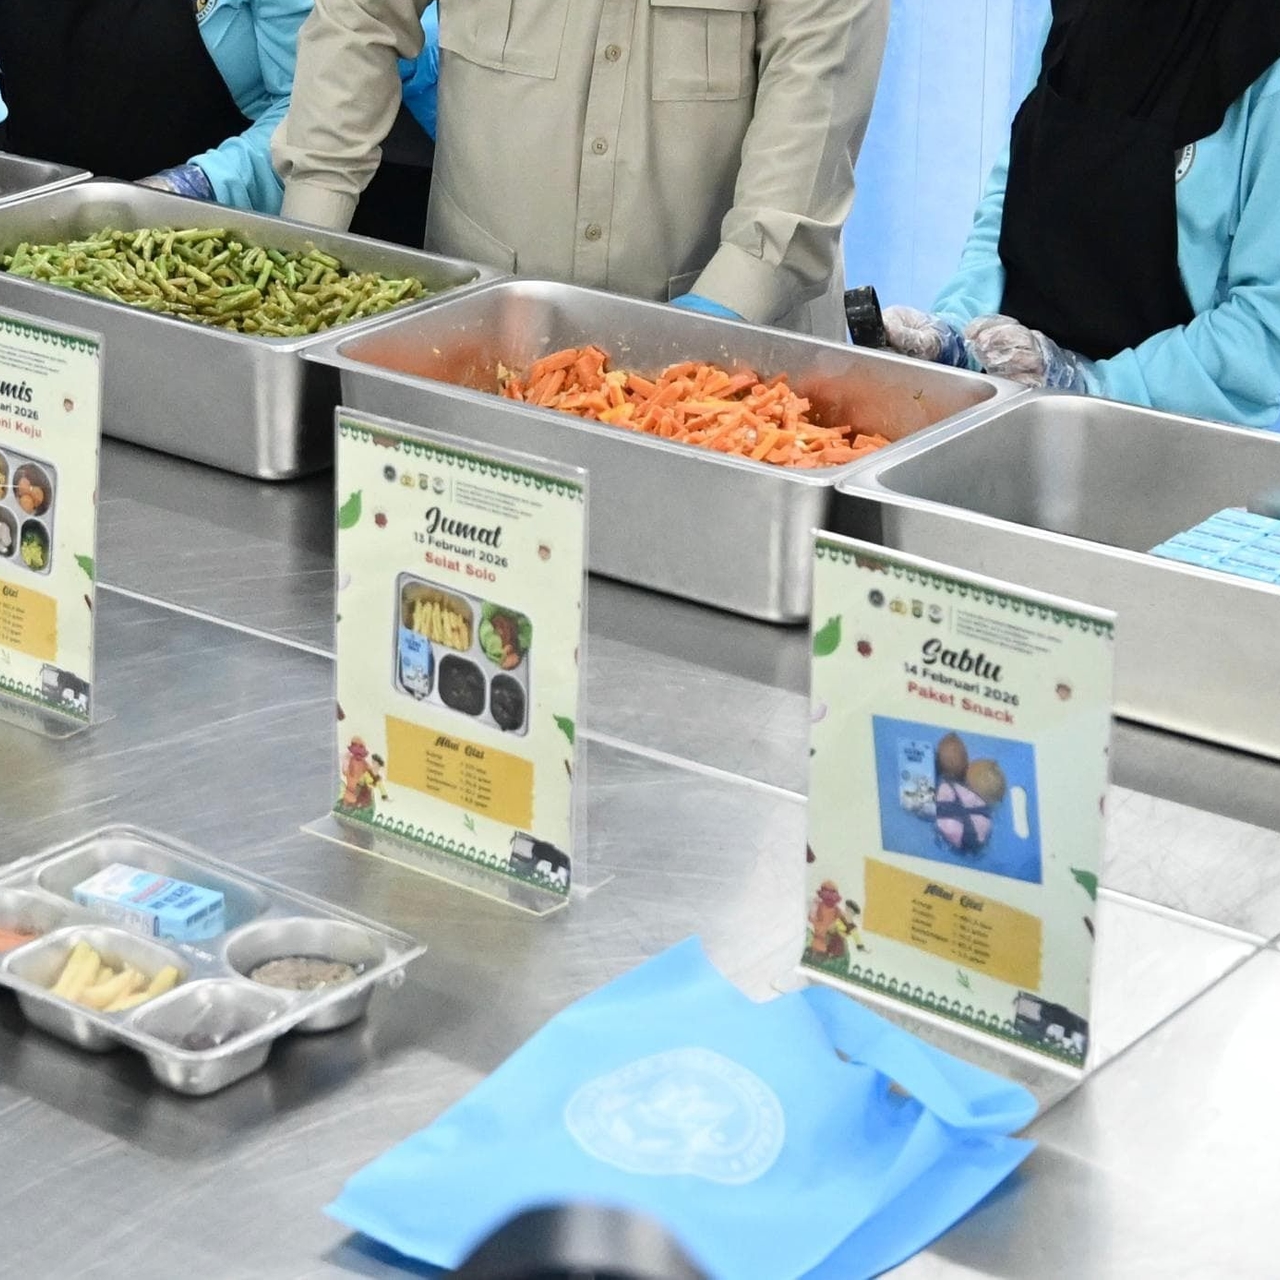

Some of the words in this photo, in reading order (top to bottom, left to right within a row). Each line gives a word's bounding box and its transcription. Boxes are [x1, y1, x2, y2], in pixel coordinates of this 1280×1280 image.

[14, 406, 39, 420] 2026
[15, 422, 42, 438] Keju
[425, 506, 502, 548] Jumat
[413, 531, 425, 543] 13
[428, 535, 475, 558] Februari
[479, 551, 509, 568] 2026
[425, 551, 460, 571] Selat
[465, 563, 497, 582] Solo
[922, 638, 1003, 682] Sabtu
[904, 662, 918, 676] 14
[922, 666, 980, 694] Februari
[983, 685, 1020, 707] 2026
[907, 681, 955, 706] Paket
[961, 697, 1015, 724] Snack
